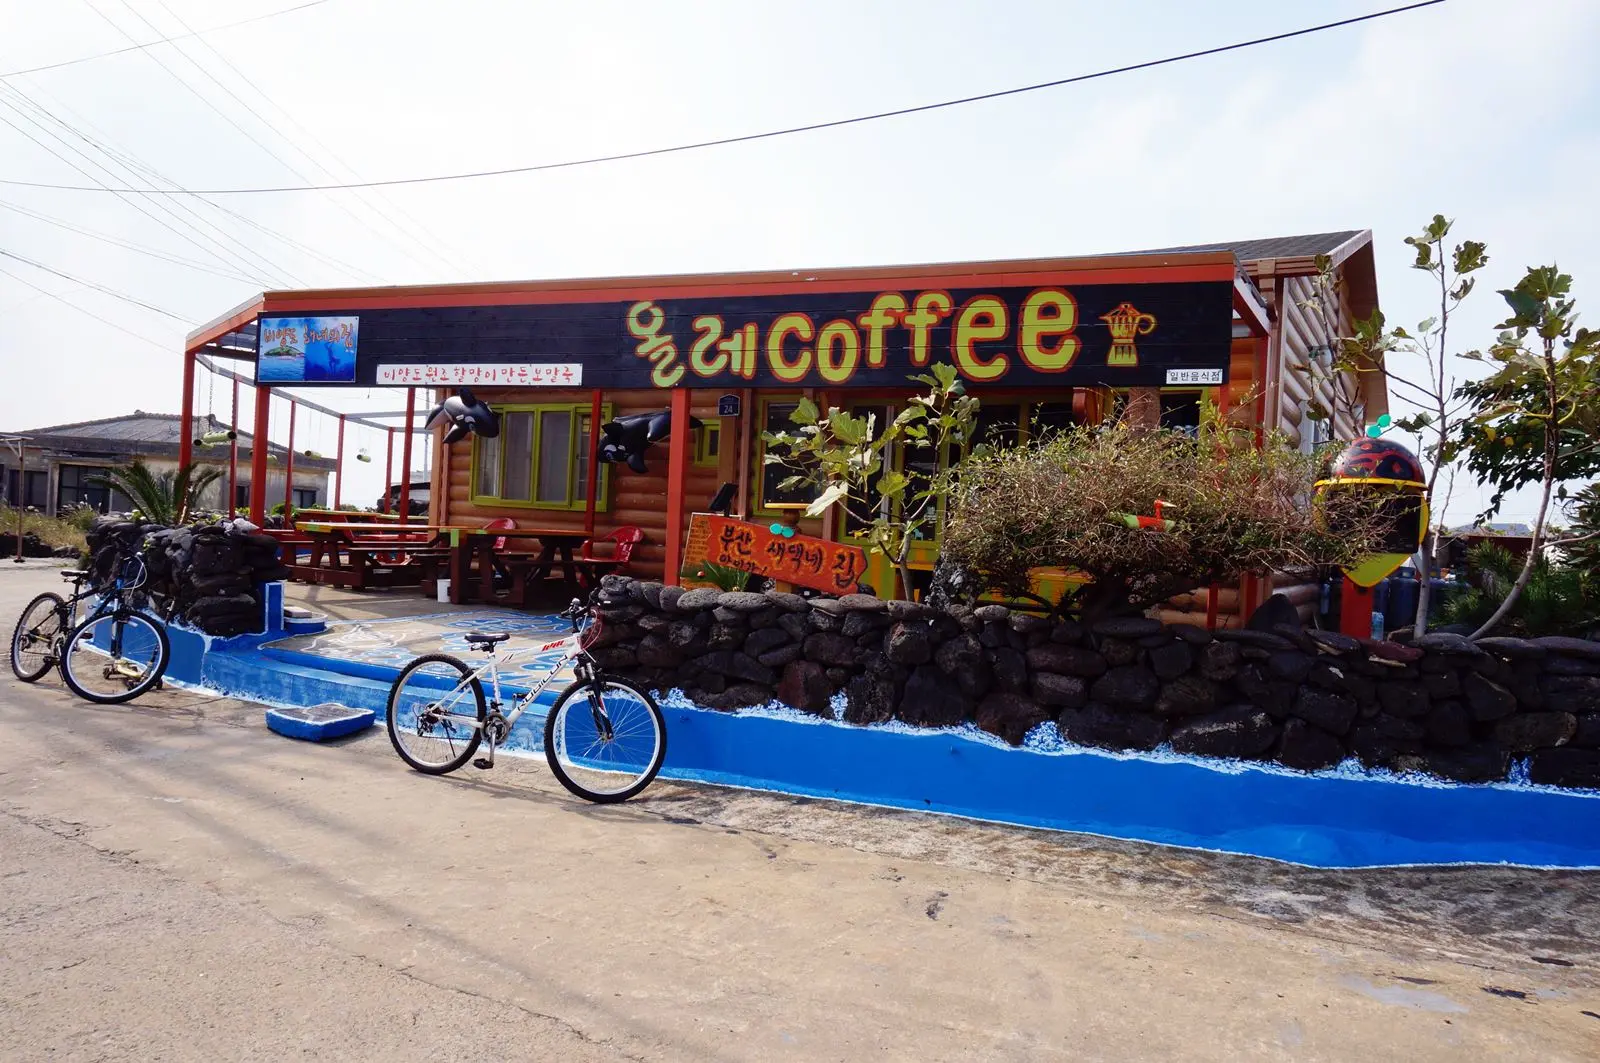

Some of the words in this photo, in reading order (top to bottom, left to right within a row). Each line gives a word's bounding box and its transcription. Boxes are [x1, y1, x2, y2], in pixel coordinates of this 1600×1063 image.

[263, 327, 298, 348] 비양도
[626, 300, 758, 388] 올레
[384, 366, 422, 383] 비양도
[425, 366, 449, 383] 원조
[453, 366, 497, 383] 할망이
[501, 366, 529, 384] 만든
[532, 366, 574, 384] 보말죽
[1170, 371, 1220, 382] 일반음식점
[724, 405, 733, 414] 24
[720, 524, 753, 556] 부산
[833, 551, 855, 588] 집
